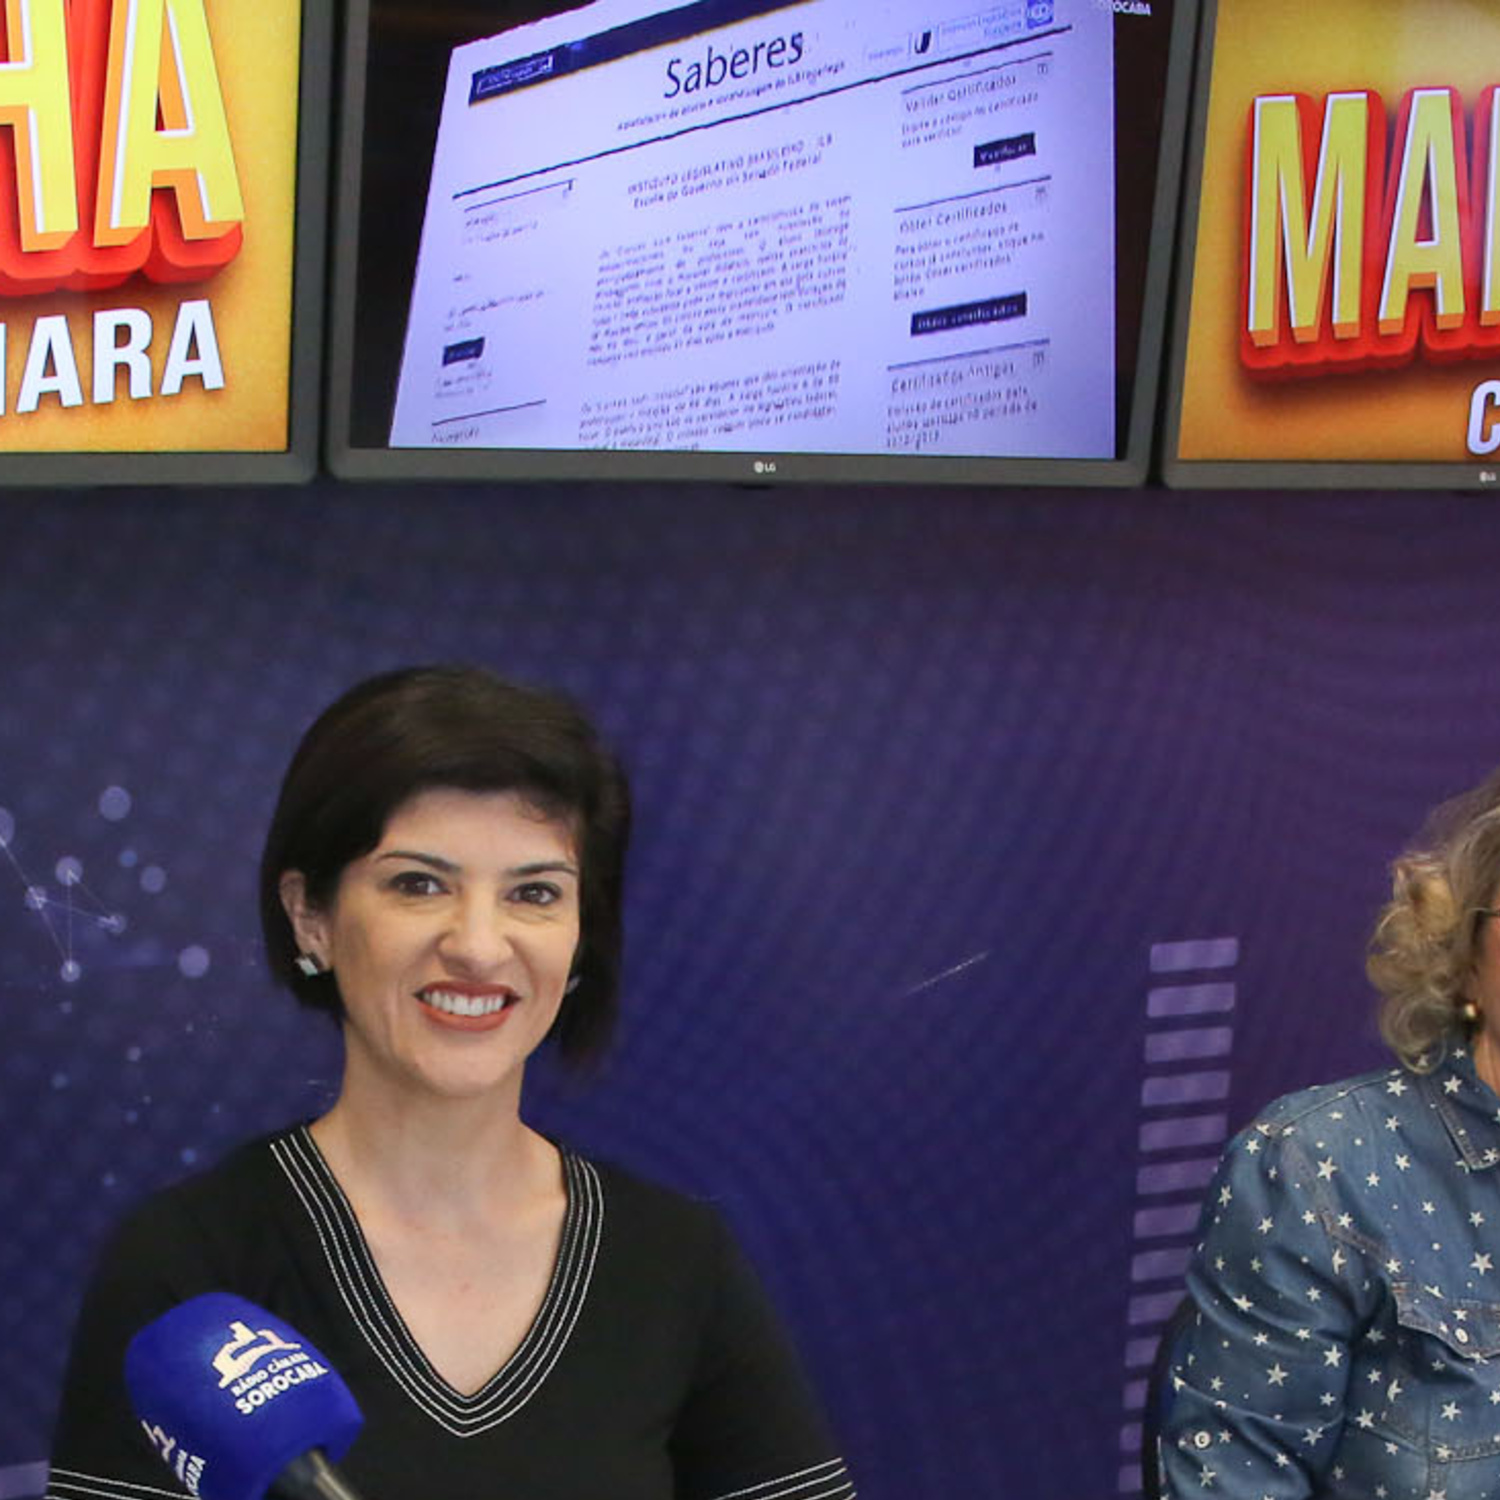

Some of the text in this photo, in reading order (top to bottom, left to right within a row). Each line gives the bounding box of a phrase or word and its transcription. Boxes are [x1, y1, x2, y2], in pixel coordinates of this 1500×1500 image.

[664, 32, 802, 99] Saberes
[0, 298, 226, 417] ARA
[230, 1368, 269, 1397] RÁDIO
[235, 1362, 329, 1415] SOROCABA
